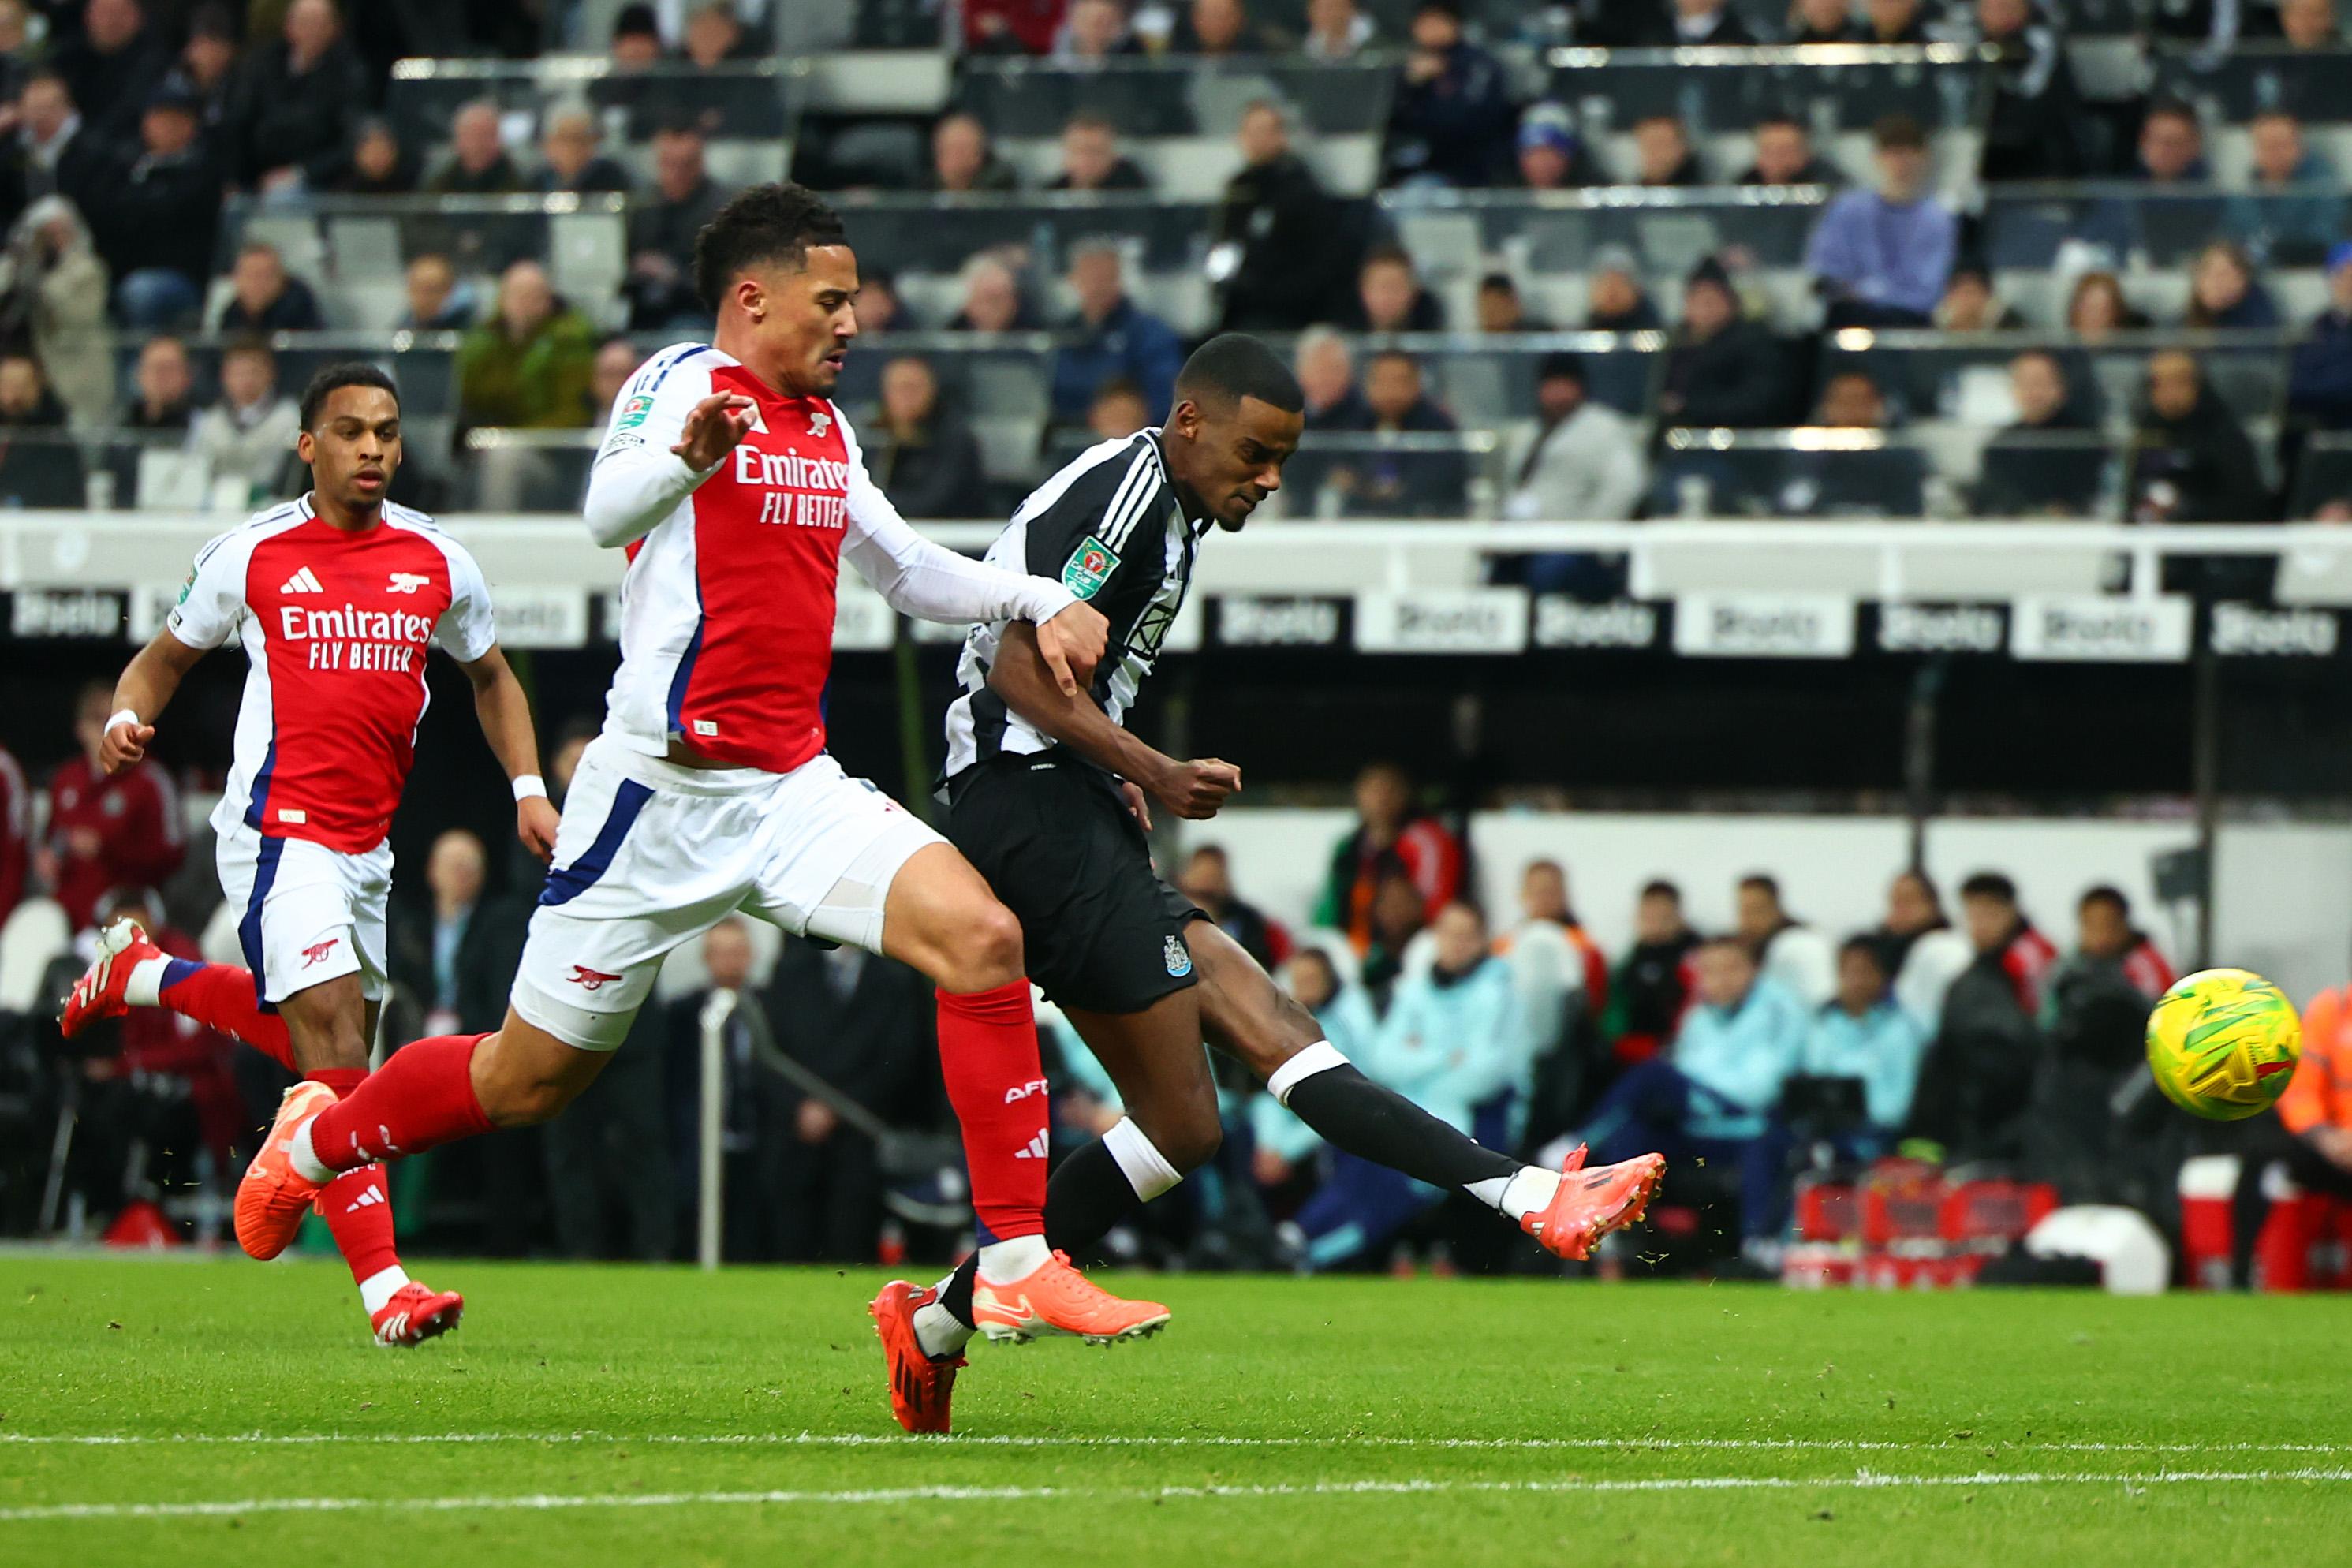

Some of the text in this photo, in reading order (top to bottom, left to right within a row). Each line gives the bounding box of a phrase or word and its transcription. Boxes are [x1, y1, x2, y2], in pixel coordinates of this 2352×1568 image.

[735, 444, 849, 491] Emirate
[759, 492, 793, 524] FLY
[279, 603, 431, 644] Emirates
[309, 641, 413, 672] FLY BETTER
